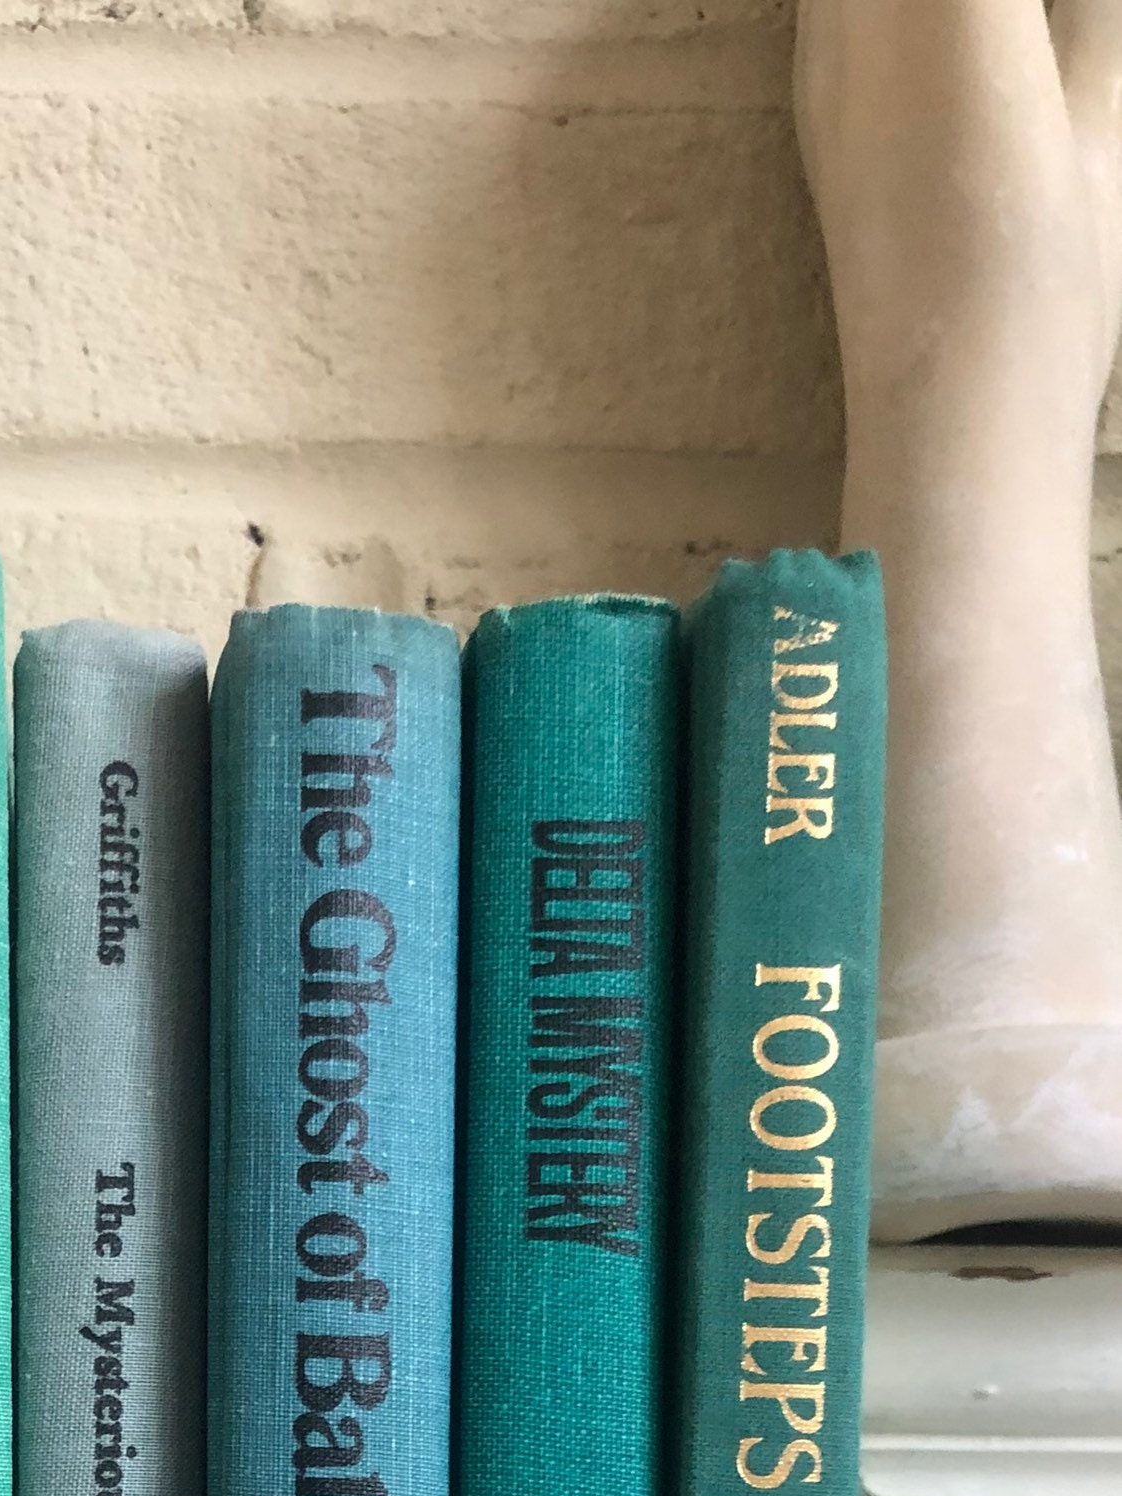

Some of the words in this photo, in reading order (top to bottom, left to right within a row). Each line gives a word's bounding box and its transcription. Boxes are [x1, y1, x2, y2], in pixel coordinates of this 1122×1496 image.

[300, 663, 398, 870] The
[764, 605, 840, 846] ADLER
[98, 758, 141, 967] Griffiths
[529, 819, 646, 980] DELTA
[296, 888, 397, 1195] Ghost
[525, 996, 644, 1257] MYSTERY
[94, 1162, 136, 1259] The
[294, 1211, 392, 1312] of
[736, 962, 842, 1491] FOOTSTEPS
